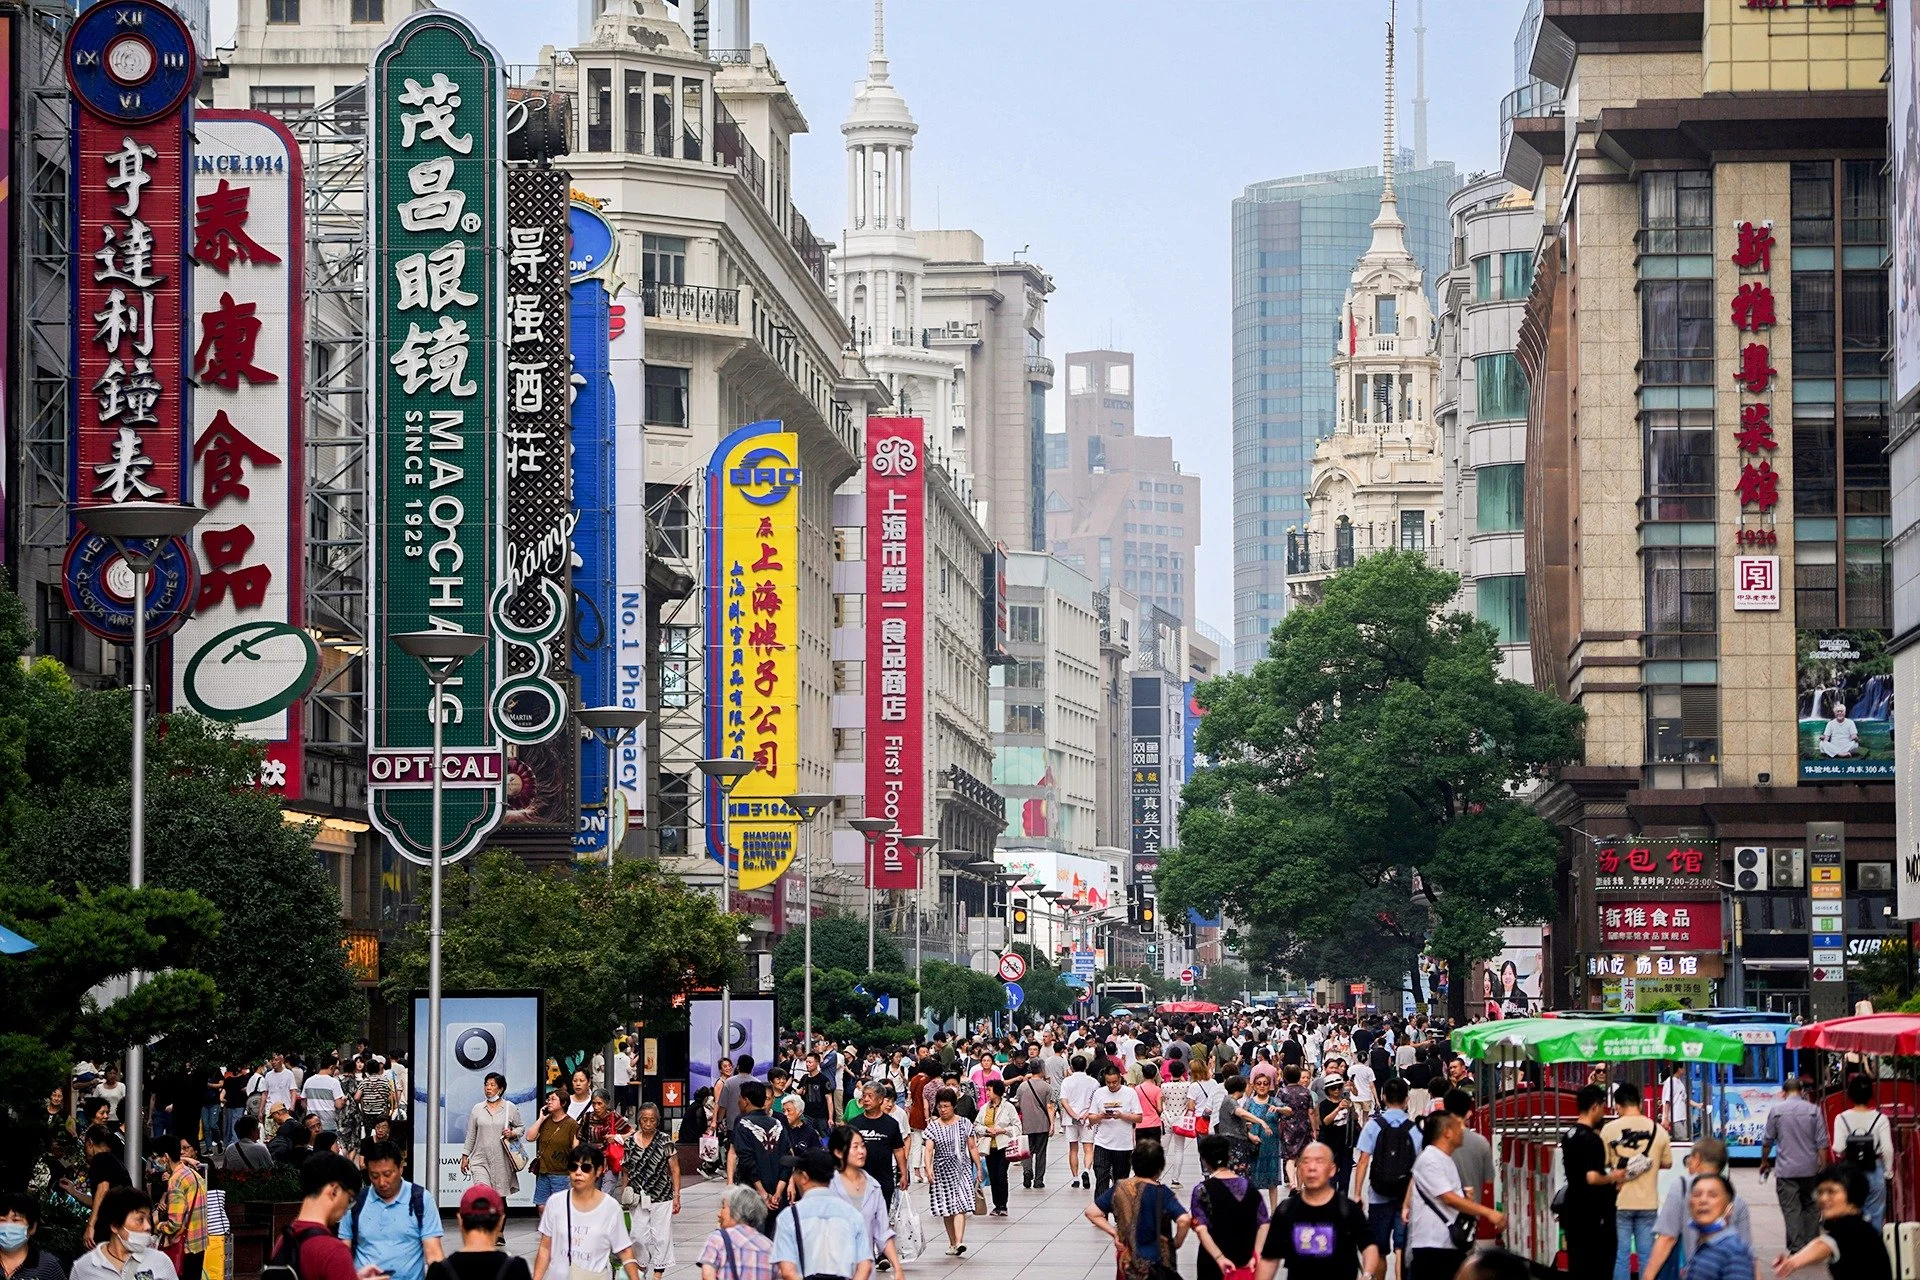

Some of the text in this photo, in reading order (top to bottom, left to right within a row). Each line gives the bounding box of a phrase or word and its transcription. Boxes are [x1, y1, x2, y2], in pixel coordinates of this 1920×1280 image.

[115, 11, 144, 27] XII
[162, 52, 185, 68] III
[118, 92, 142, 109] VI
[194, 155, 284, 172] INCE.1914
[389, 72, 479, 398] 茂昌眼镜
[194, 178, 283, 613] 泰康食品
[403, 410, 424, 559] SINCE 1923
[1735, 529, 1778, 546] 1926
[881, 489, 908, 721] 上海市第一食品商店
[619, 592, 641, 793] No.1 Phamacy
[884, 735, 904, 774] First
[371, 756, 499, 781] OPTCAL
[1142, 796, 1160, 854] 真丝大王
[742, 831, 792, 841] SHANGHAI
[743, 850, 787, 860] ARTICLES
[1598, 847, 1704, 874] 汤包馆
[1666, 877, 1713, 887] 7:00-23:00
[1605, 907, 1691, 928] 新雅食品
[1587, 955, 1698, 976] 海小吃 汤包馆
[560, 1249, 593, 1261] OFICE
